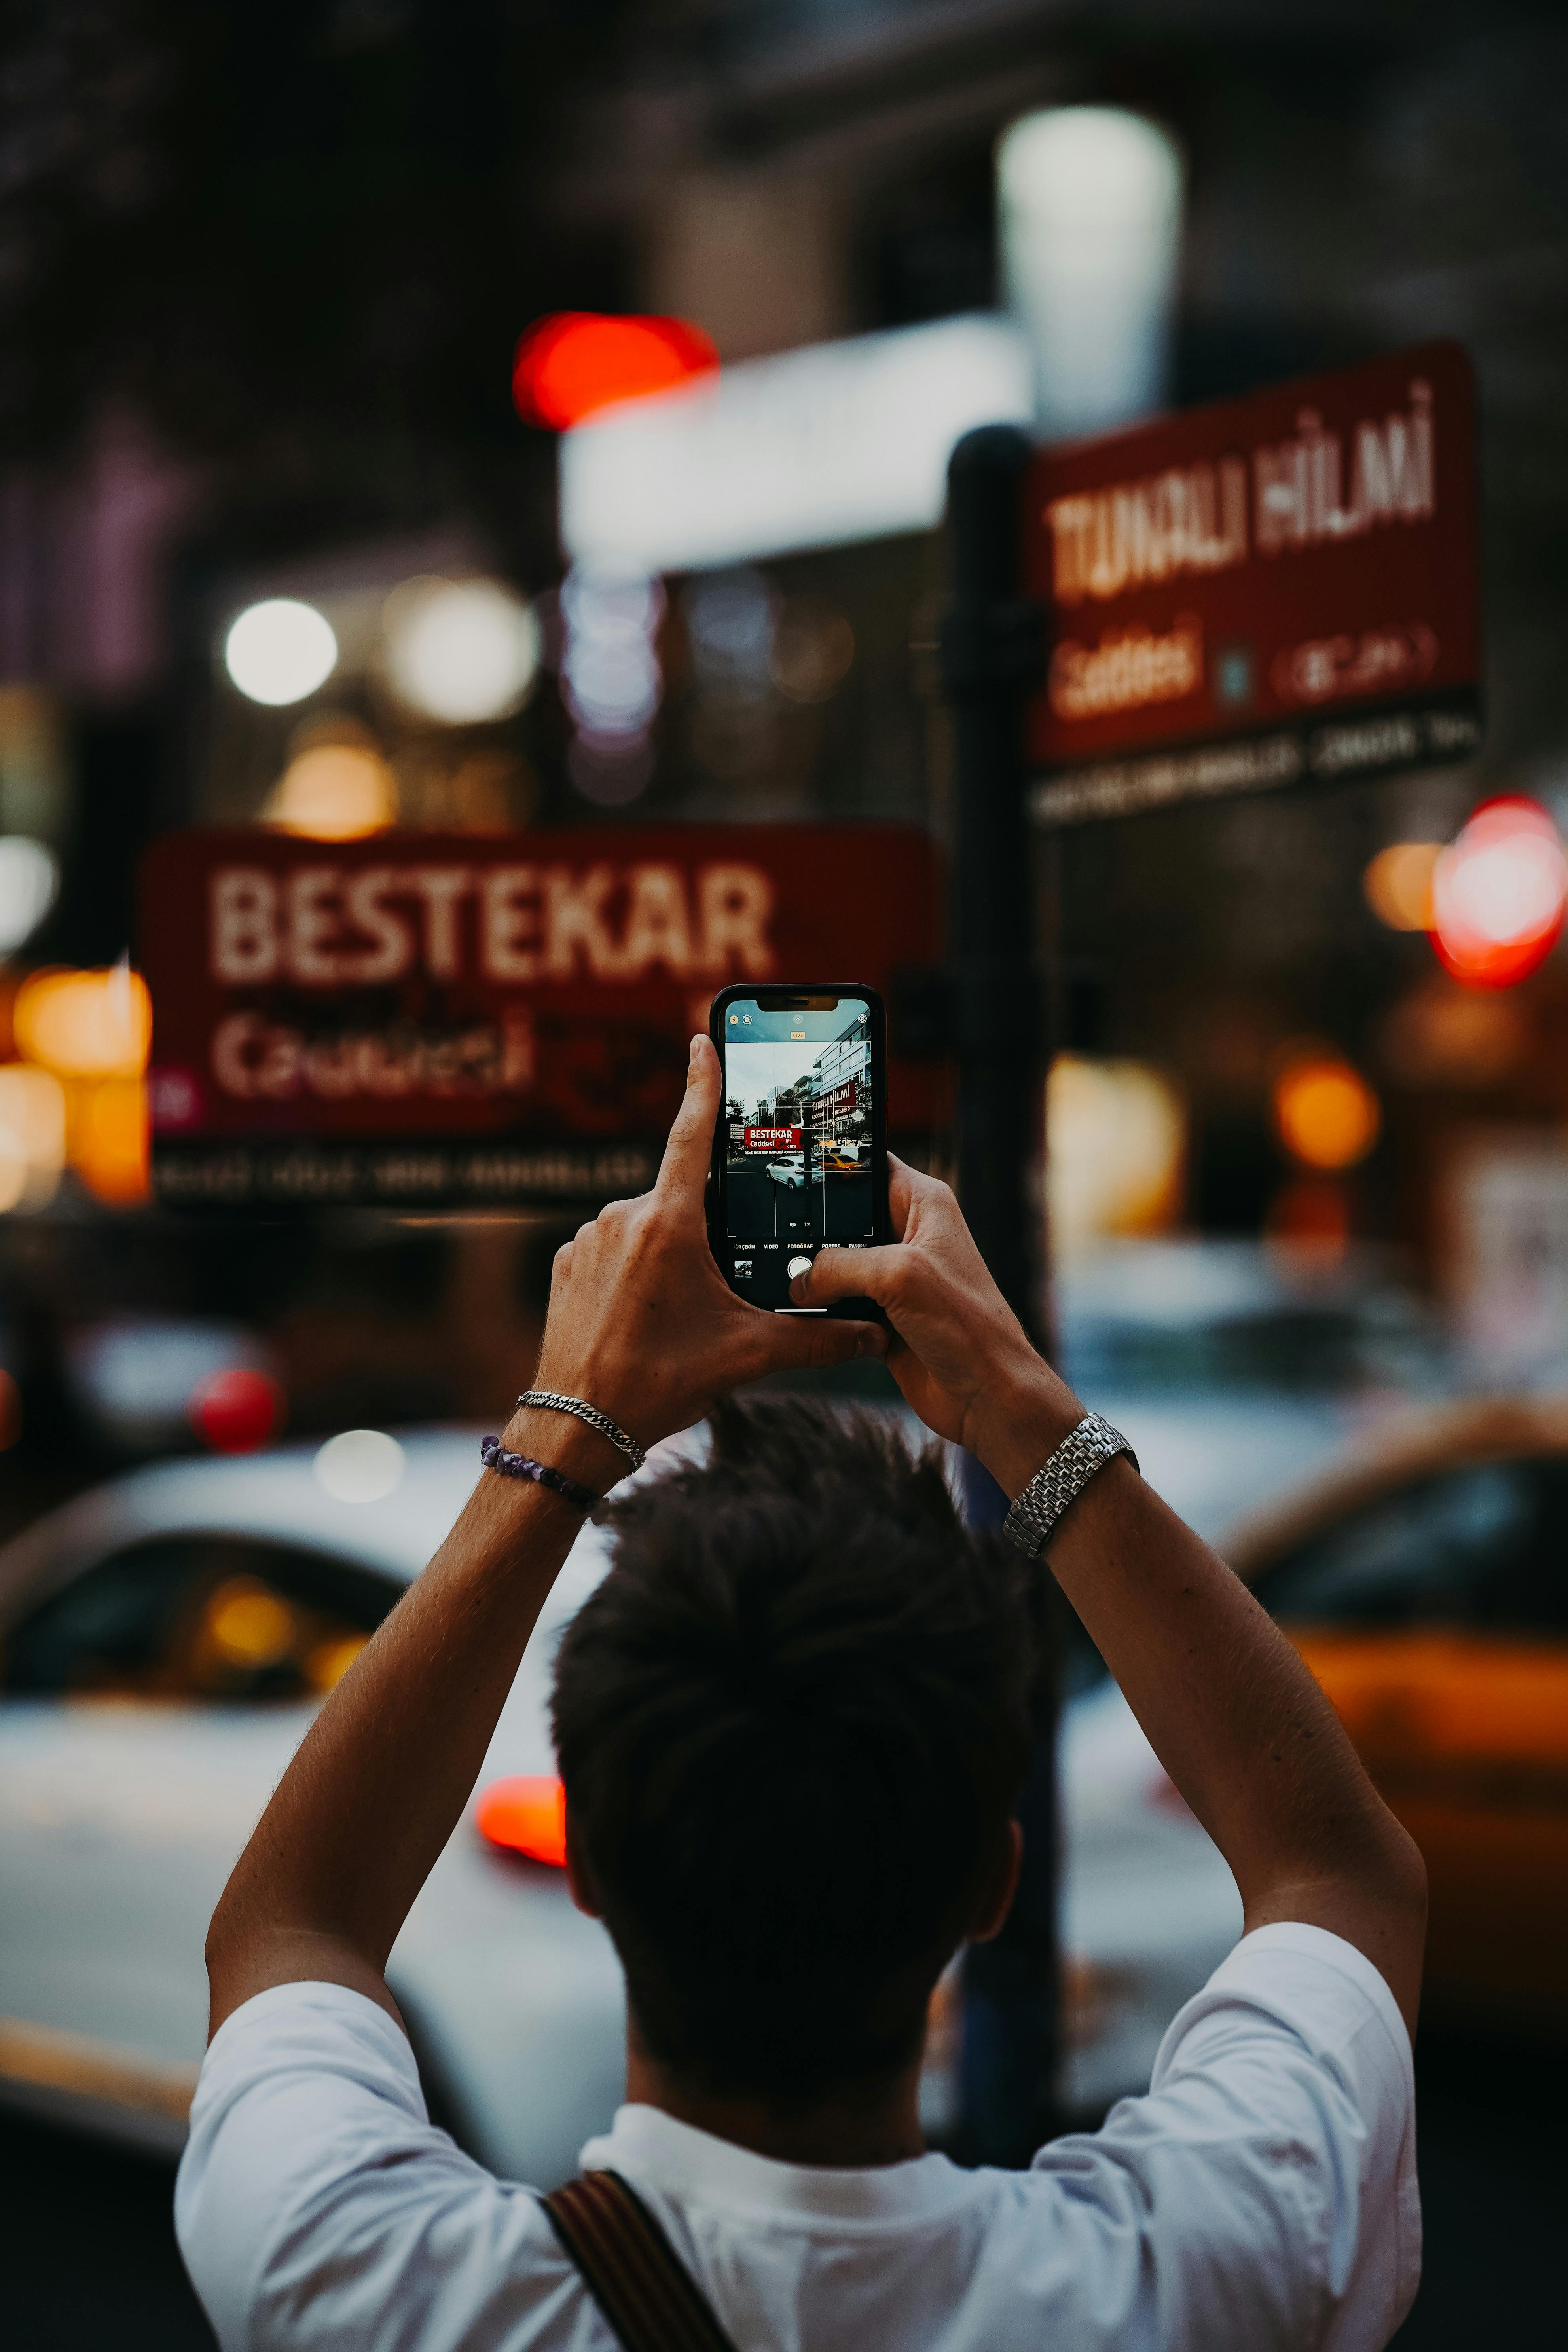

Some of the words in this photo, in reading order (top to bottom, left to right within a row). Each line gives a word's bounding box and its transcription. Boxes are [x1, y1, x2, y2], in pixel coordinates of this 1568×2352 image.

[1044, 459, 1246, 606] TUNALI
[1254, 378, 1435, 556] HİLMİ
[210, 863, 777, 983] BESTEKAR
[812, 1097, 829, 1112] TUNALI
[830, 1084, 850, 1104] HİLMİ
[812, 1111, 824, 1119] Caddesi
[750, 1130, 792, 1139] BESTEKAR
